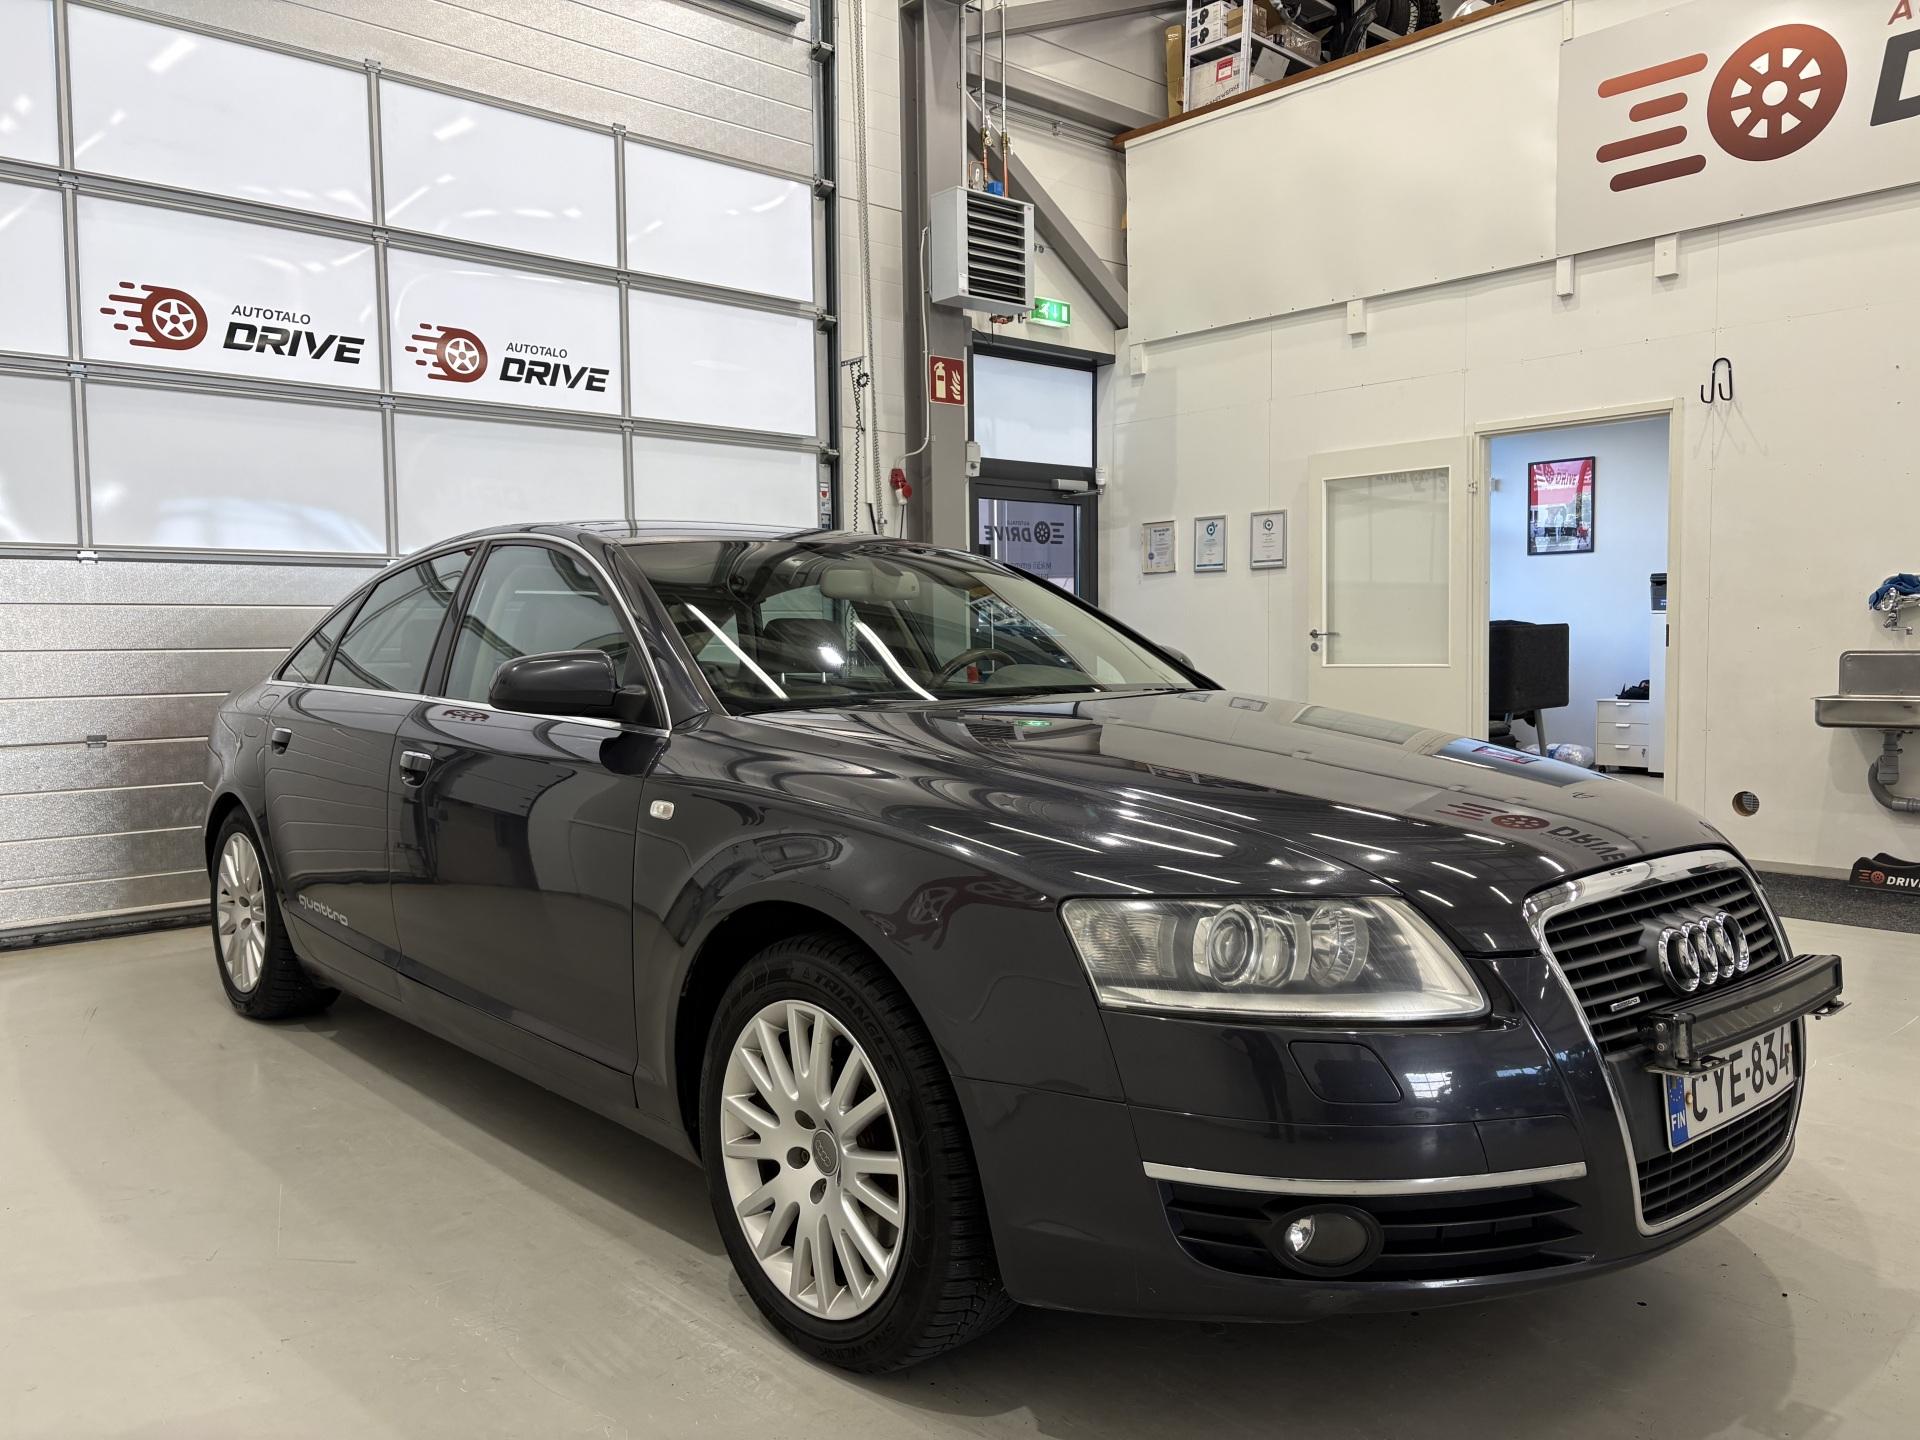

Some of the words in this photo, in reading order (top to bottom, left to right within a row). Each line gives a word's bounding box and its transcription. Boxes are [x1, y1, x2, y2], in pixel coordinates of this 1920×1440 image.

[1887, 0, 1920, 25] A
[231, 304, 311, 325] AUTOTALO
[223, 321, 365, 364] DRIVE
[506, 342, 567, 358] AUTOTALO
[499, 356, 610, 392] DRIVE
[1555, 472, 1578, 485] DRIVE
[1886, 876, 1920, 888] DRIV
[298, 894, 348, 926] quattro
[815, 973, 898, 1072] TRIANGLE
[1692, 1026, 1790, 1122] CYE-834
[1671, 1109, 1686, 1131] FIN
